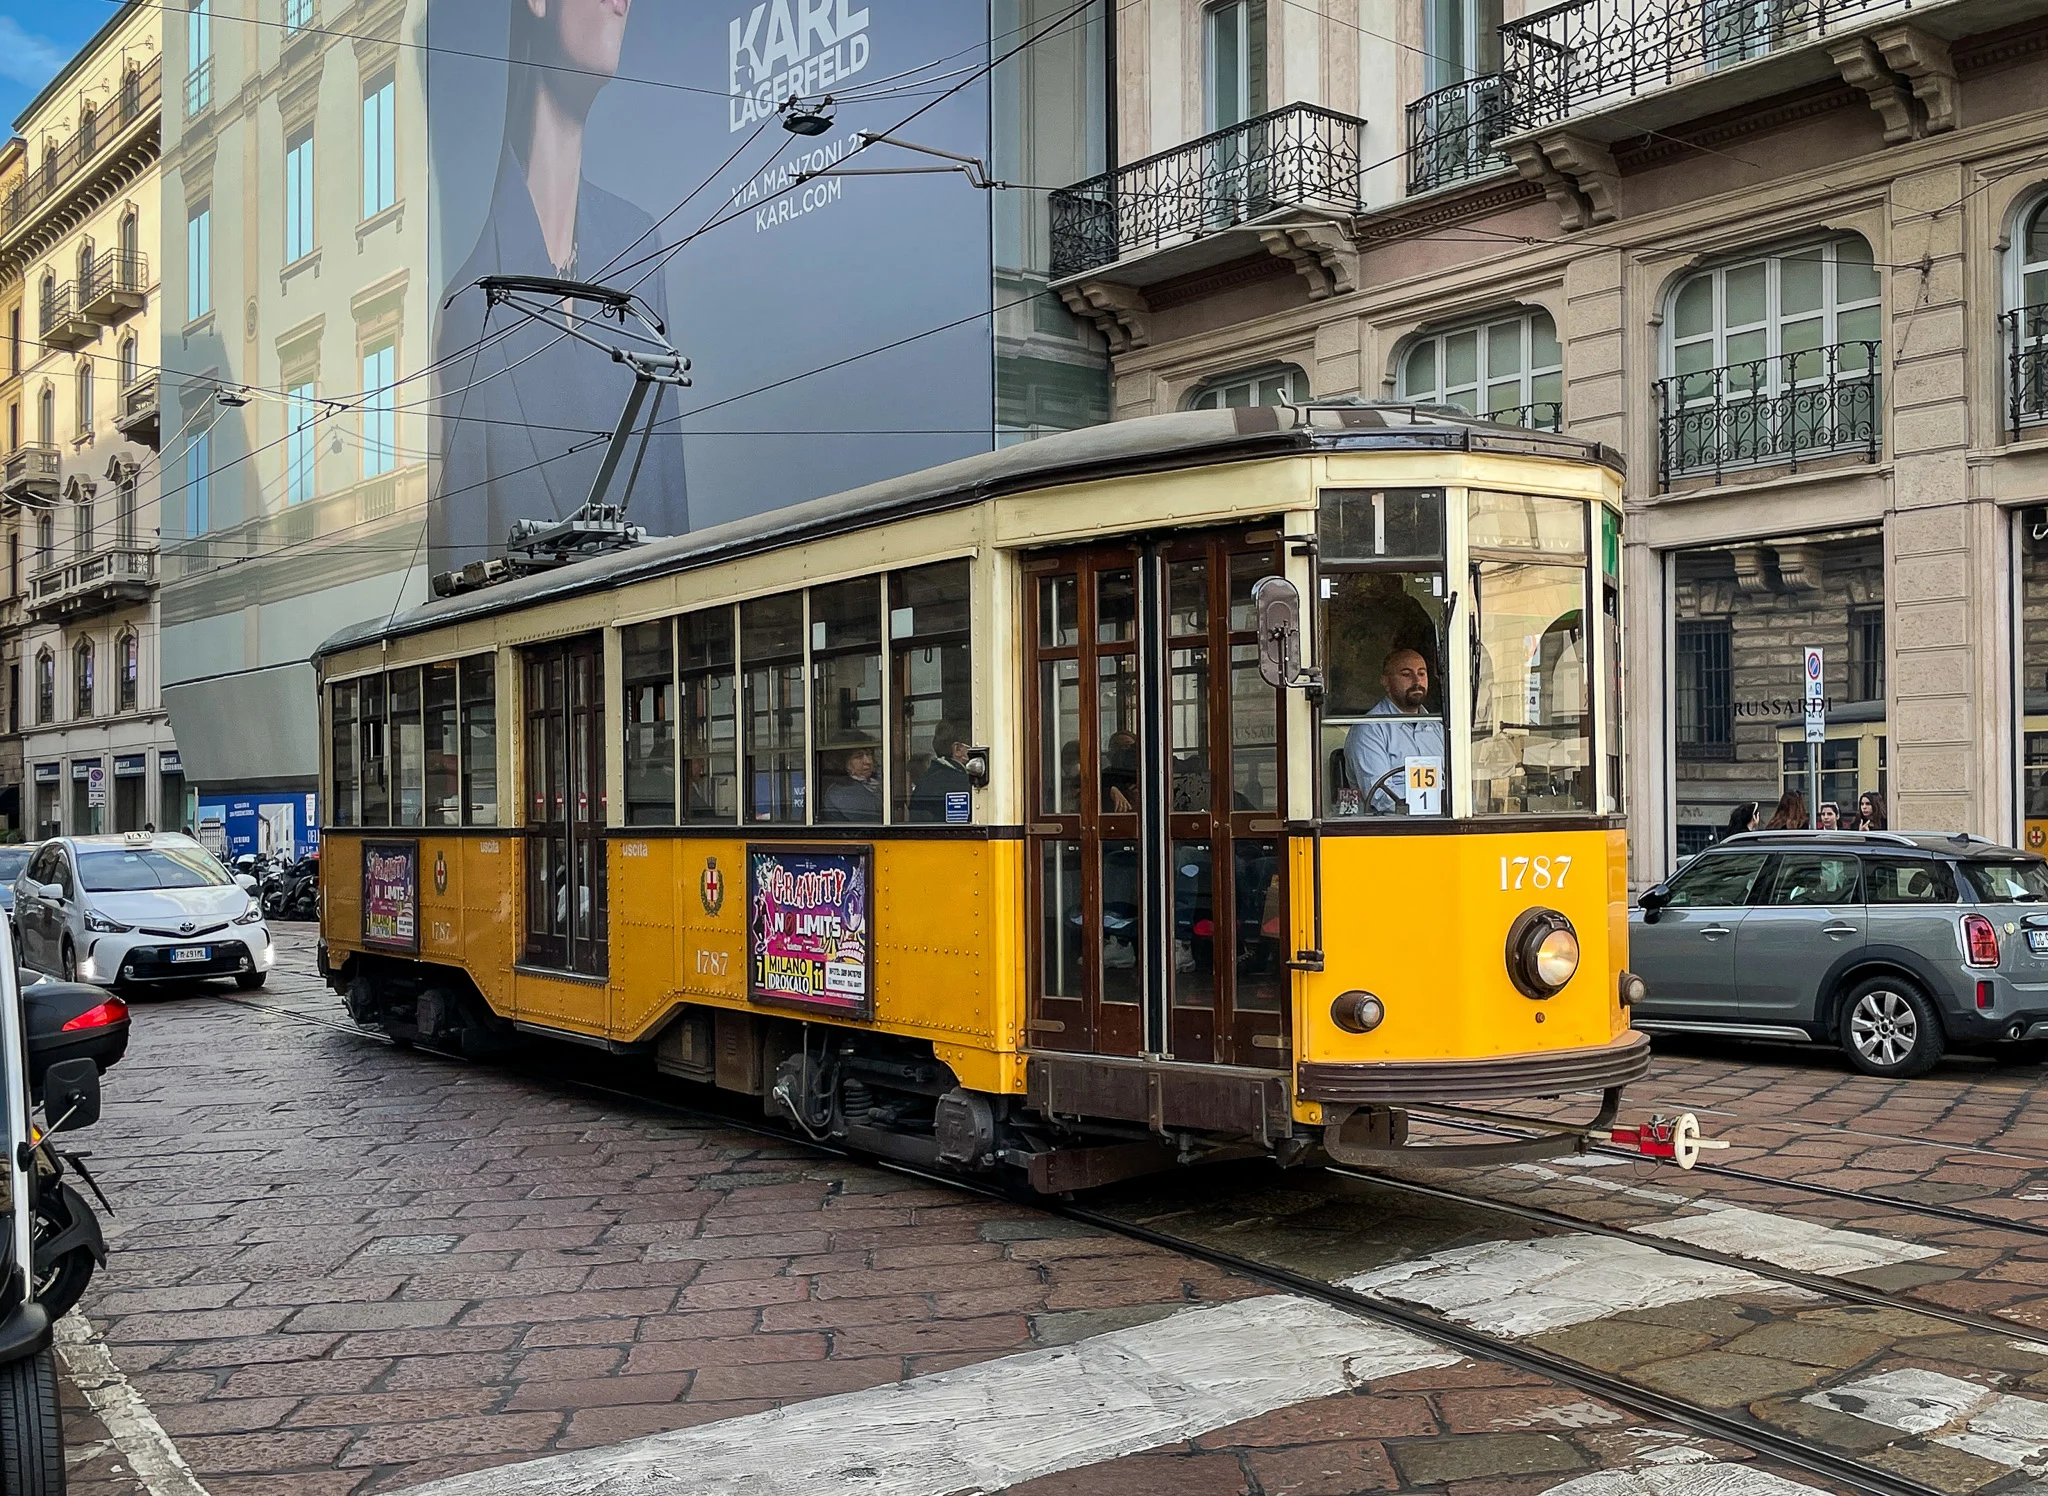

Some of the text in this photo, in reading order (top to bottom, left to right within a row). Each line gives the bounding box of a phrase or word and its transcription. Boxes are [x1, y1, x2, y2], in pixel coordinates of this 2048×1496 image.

[729, 0, 869, 95] KARL
[730, 33, 870, 133] LAGERFELD
[732, 178, 759, 208] VIA
[763, 139, 842, 196] MANZONI
[756, 177, 842, 233] KARL.COM
[1413, 768, 1435, 788] 15
[1419, 791, 1427, 810] 1
[127, 832, 150, 841] TAXI
[622, 842, 648, 857] uscita
[1500, 855, 1572, 891] 1787
[772, 865, 846, 909] GRAVITY
[796, 913, 841, 938] LIMITS
[697, 949, 729, 976] 1787
[757, 961, 762, 982] 7
[769, 958, 808, 977] MILANO
[768, 973, 810, 994] IDROSCALO
[813, 969, 823, 990] 11
